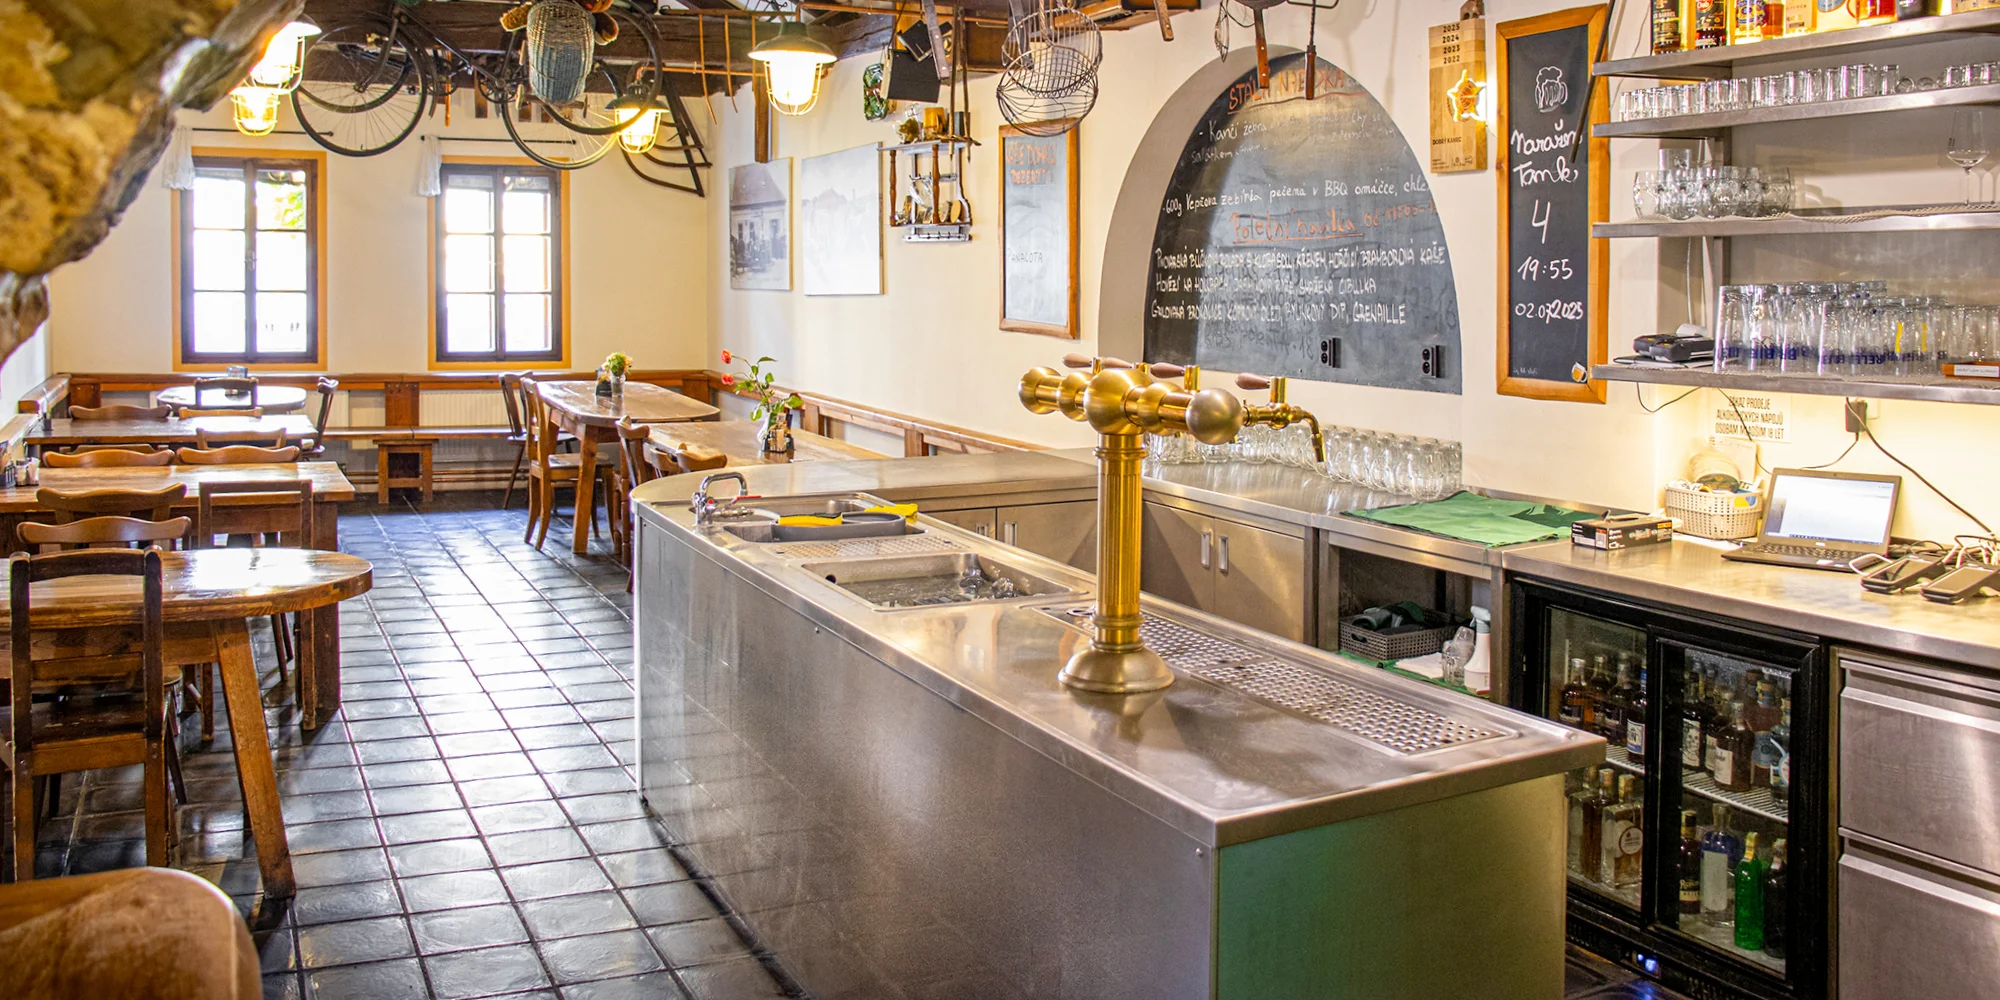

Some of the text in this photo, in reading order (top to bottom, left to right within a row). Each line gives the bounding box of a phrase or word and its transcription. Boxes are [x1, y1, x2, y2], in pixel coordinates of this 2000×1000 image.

[1443, 23, 1461, 33] 2025
[1442, 35, 1460, 44] 2024
[1443, 45, 1461, 54] 2023
[1443, 55, 1461, 64] 2022
[1208, 120, 1238, 142] Kančí
[1324, 180, 1348, 197] BBQ
[1354, 179, 1398, 197] omáčce,
[1531, 199, 1551, 244] 4
[1420, 240, 1446, 265] KAŠE
[1517, 256, 1573, 281] 19:55
[1352, 301, 1407, 325] GRENAILLE
[1774, 427, 1785, 440] LET
